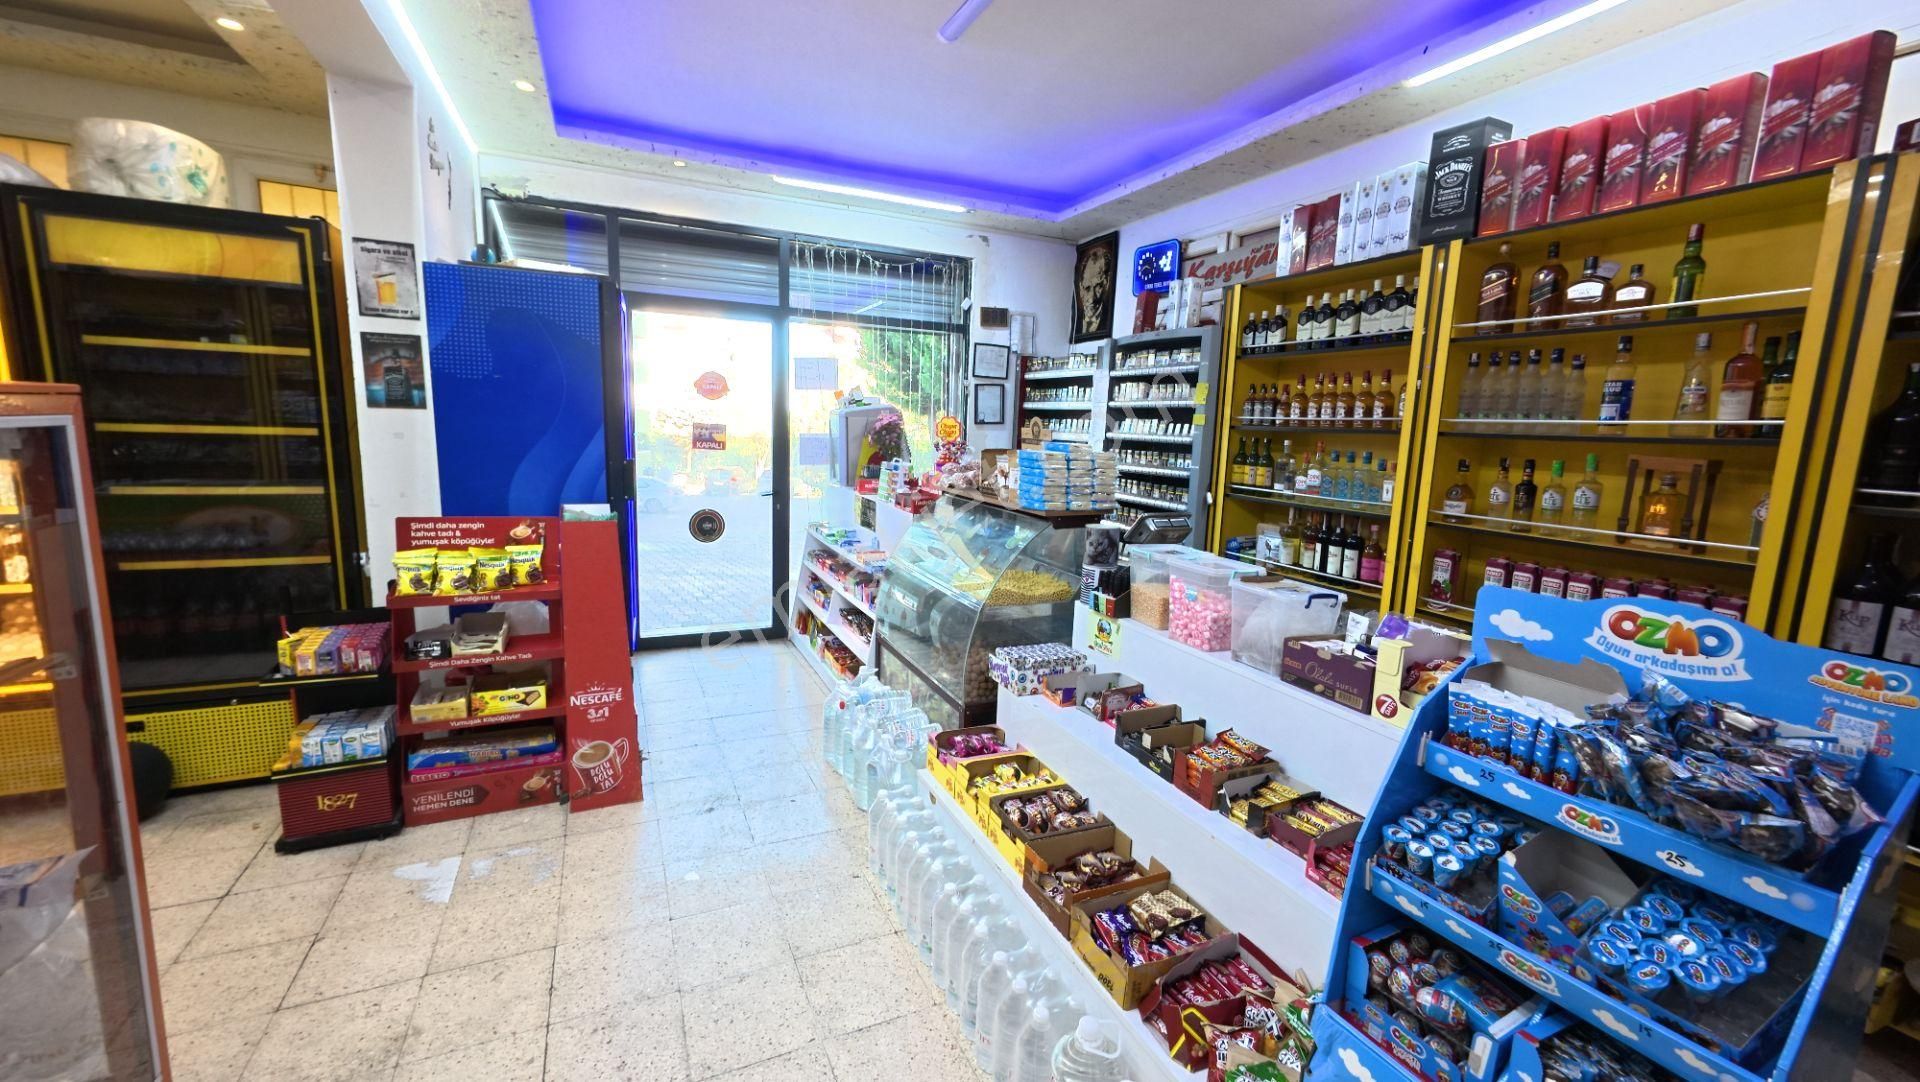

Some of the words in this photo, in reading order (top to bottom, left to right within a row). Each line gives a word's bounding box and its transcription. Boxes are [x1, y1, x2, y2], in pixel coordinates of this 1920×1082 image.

[1435, 166, 1449, 180] JACK
[1450, 162, 1473, 172] DANIEL'S
[696, 441, 723, 449] KAPALI
[410, 522, 434, 530] Şimdi
[458, 522, 485, 531] zengin
[411, 539, 449, 547] yumuşak
[451, 537, 495, 546] köpüğüyle!
[479, 561, 505, 569] Nesquik
[454, 595, 489, 603] Sevdiğiniz
[1609, 610, 1734, 658] OZMO
[429, 661, 450, 669] Şimdi
[471, 656, 494, 664] Zengin
[496, 653, 517, 661] Kahve
[1596, 635, 1631, 657] Oyun
[1634, 653, 1718, 676] arkadaşım
[1722, 663, 1738, 676] o!
[1825, 662, 1908, 692] OZMO
[1336, 682, 1358, 694] SUFLE
[570, 688, 622, 707] NESCAFÉ
[1380, 695, 1394, 715] 7
[1385, 700, 1397, 716] DAYS
[450, 717, 482, 727] Yumuşak
[483, 713, 521, 723] Köpüğüyle!
[590, 760, 610, 776] DOLU
[593, 768, 614, 785] DOLU
[1480, 769, 1496, 783] 25
[600, 776, 614, 791] TAT
[316, 792, 358, 811] 1827
[412, 787, 475, 805] YENİLENDİ
[413, 801, 448, 813] HEMEN
[449, 797, 475, 807] DENE
[1564, 805, 1617, 834] OZMO
[1665, 851, 1688, 868] 25
[1502, 885, 1541, 912] OZMO
[1504, 951, 1554, 985] OZMO
[1245, 1007, 1282, 1040] CRAX
[1391, 1026, 1425, 1058] OZMO
[1277, 1051, 1301, 1072] CRA
